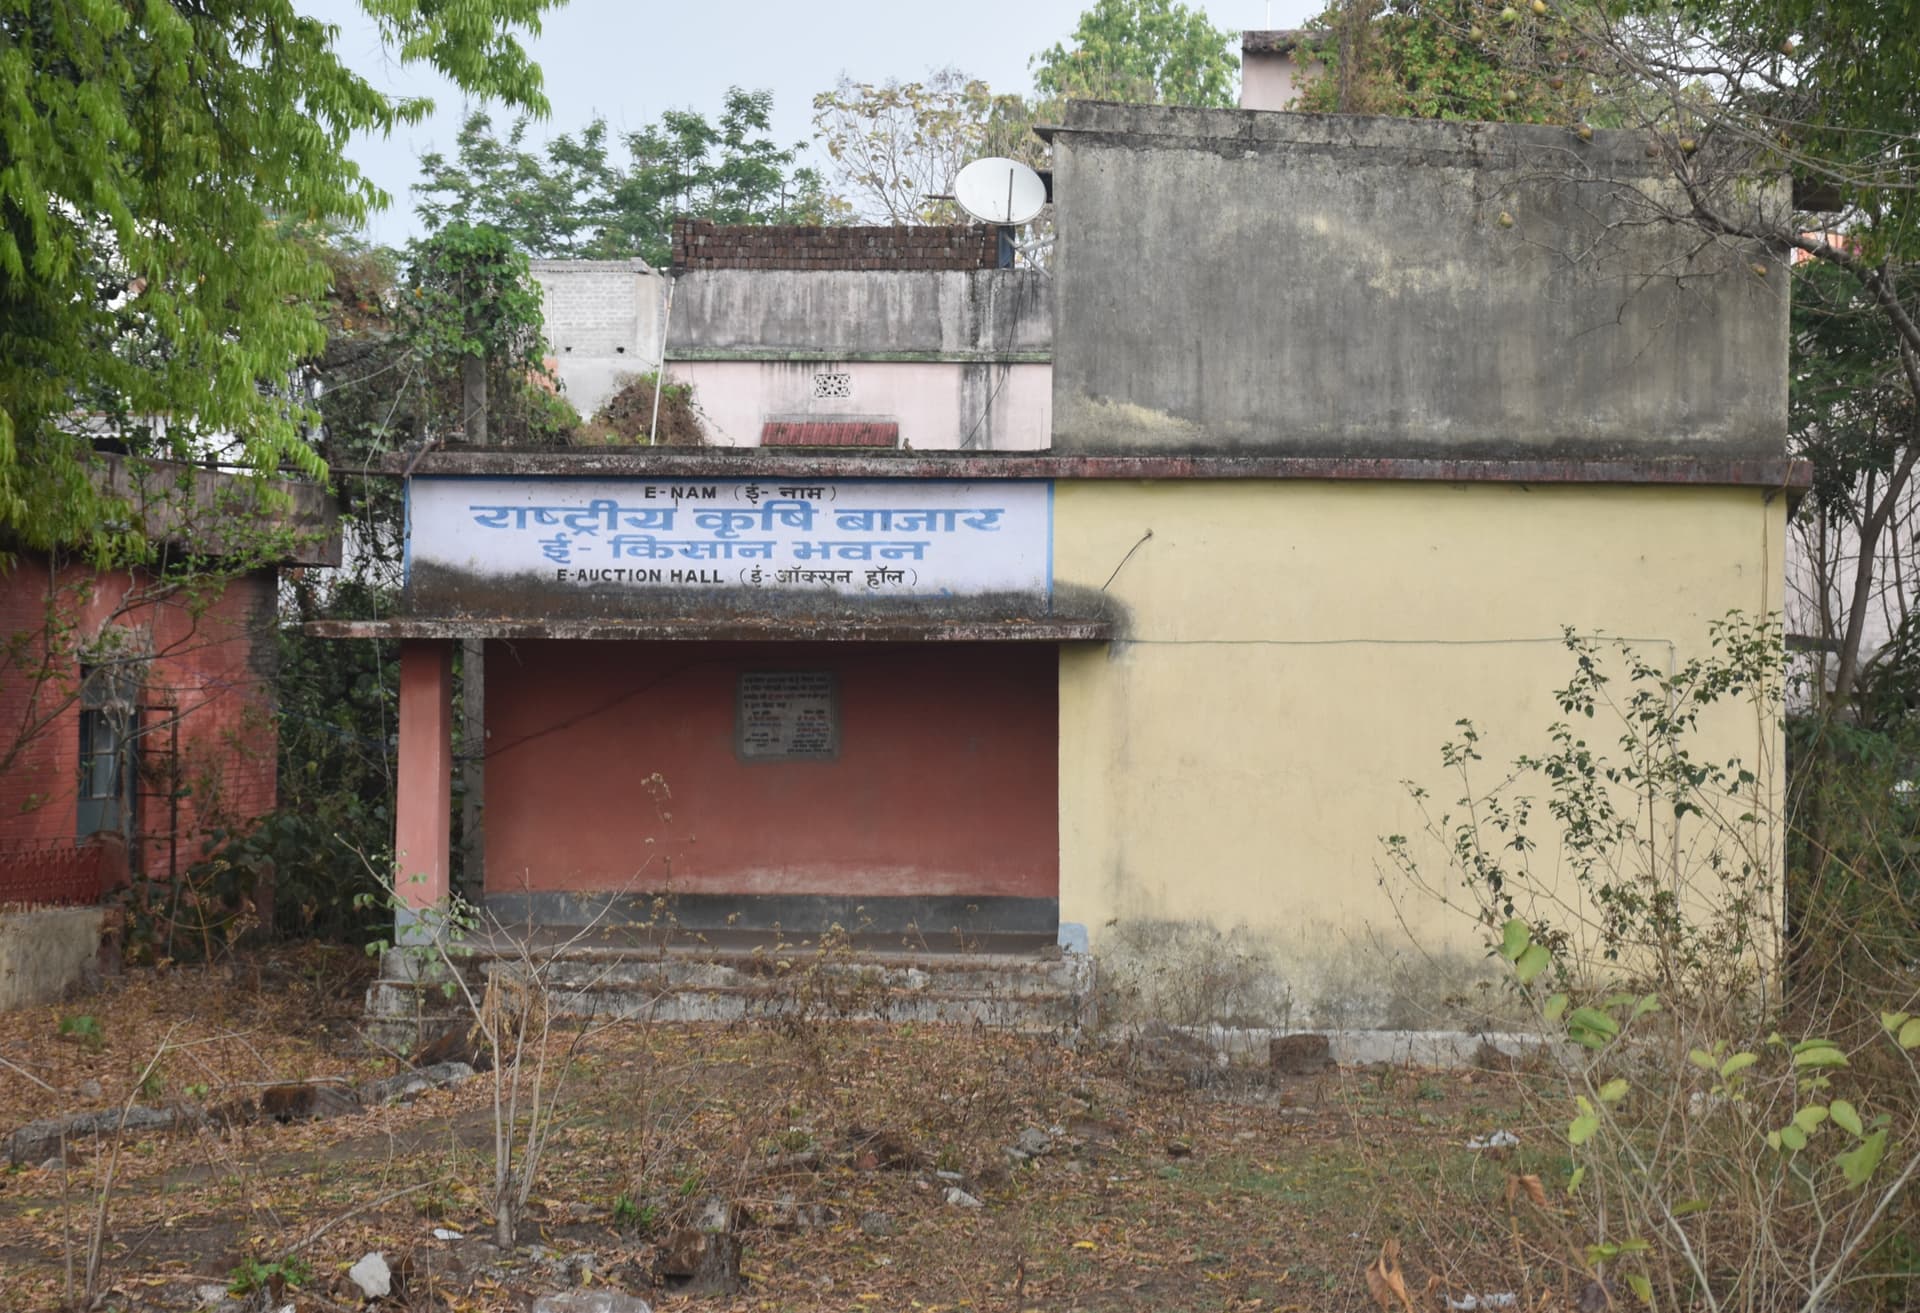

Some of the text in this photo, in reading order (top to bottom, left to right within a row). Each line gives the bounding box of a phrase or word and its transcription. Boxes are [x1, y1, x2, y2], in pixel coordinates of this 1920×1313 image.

[645, 486, 717, 499] E-NAM
[469, 499, 1005, 538] राष्ट्रीय कृषि बाजार
[792, 541, 931, 561] भवन
[557, 568, 662, 583] E-AUCTION
[671, 569, 724, 584] HALL
